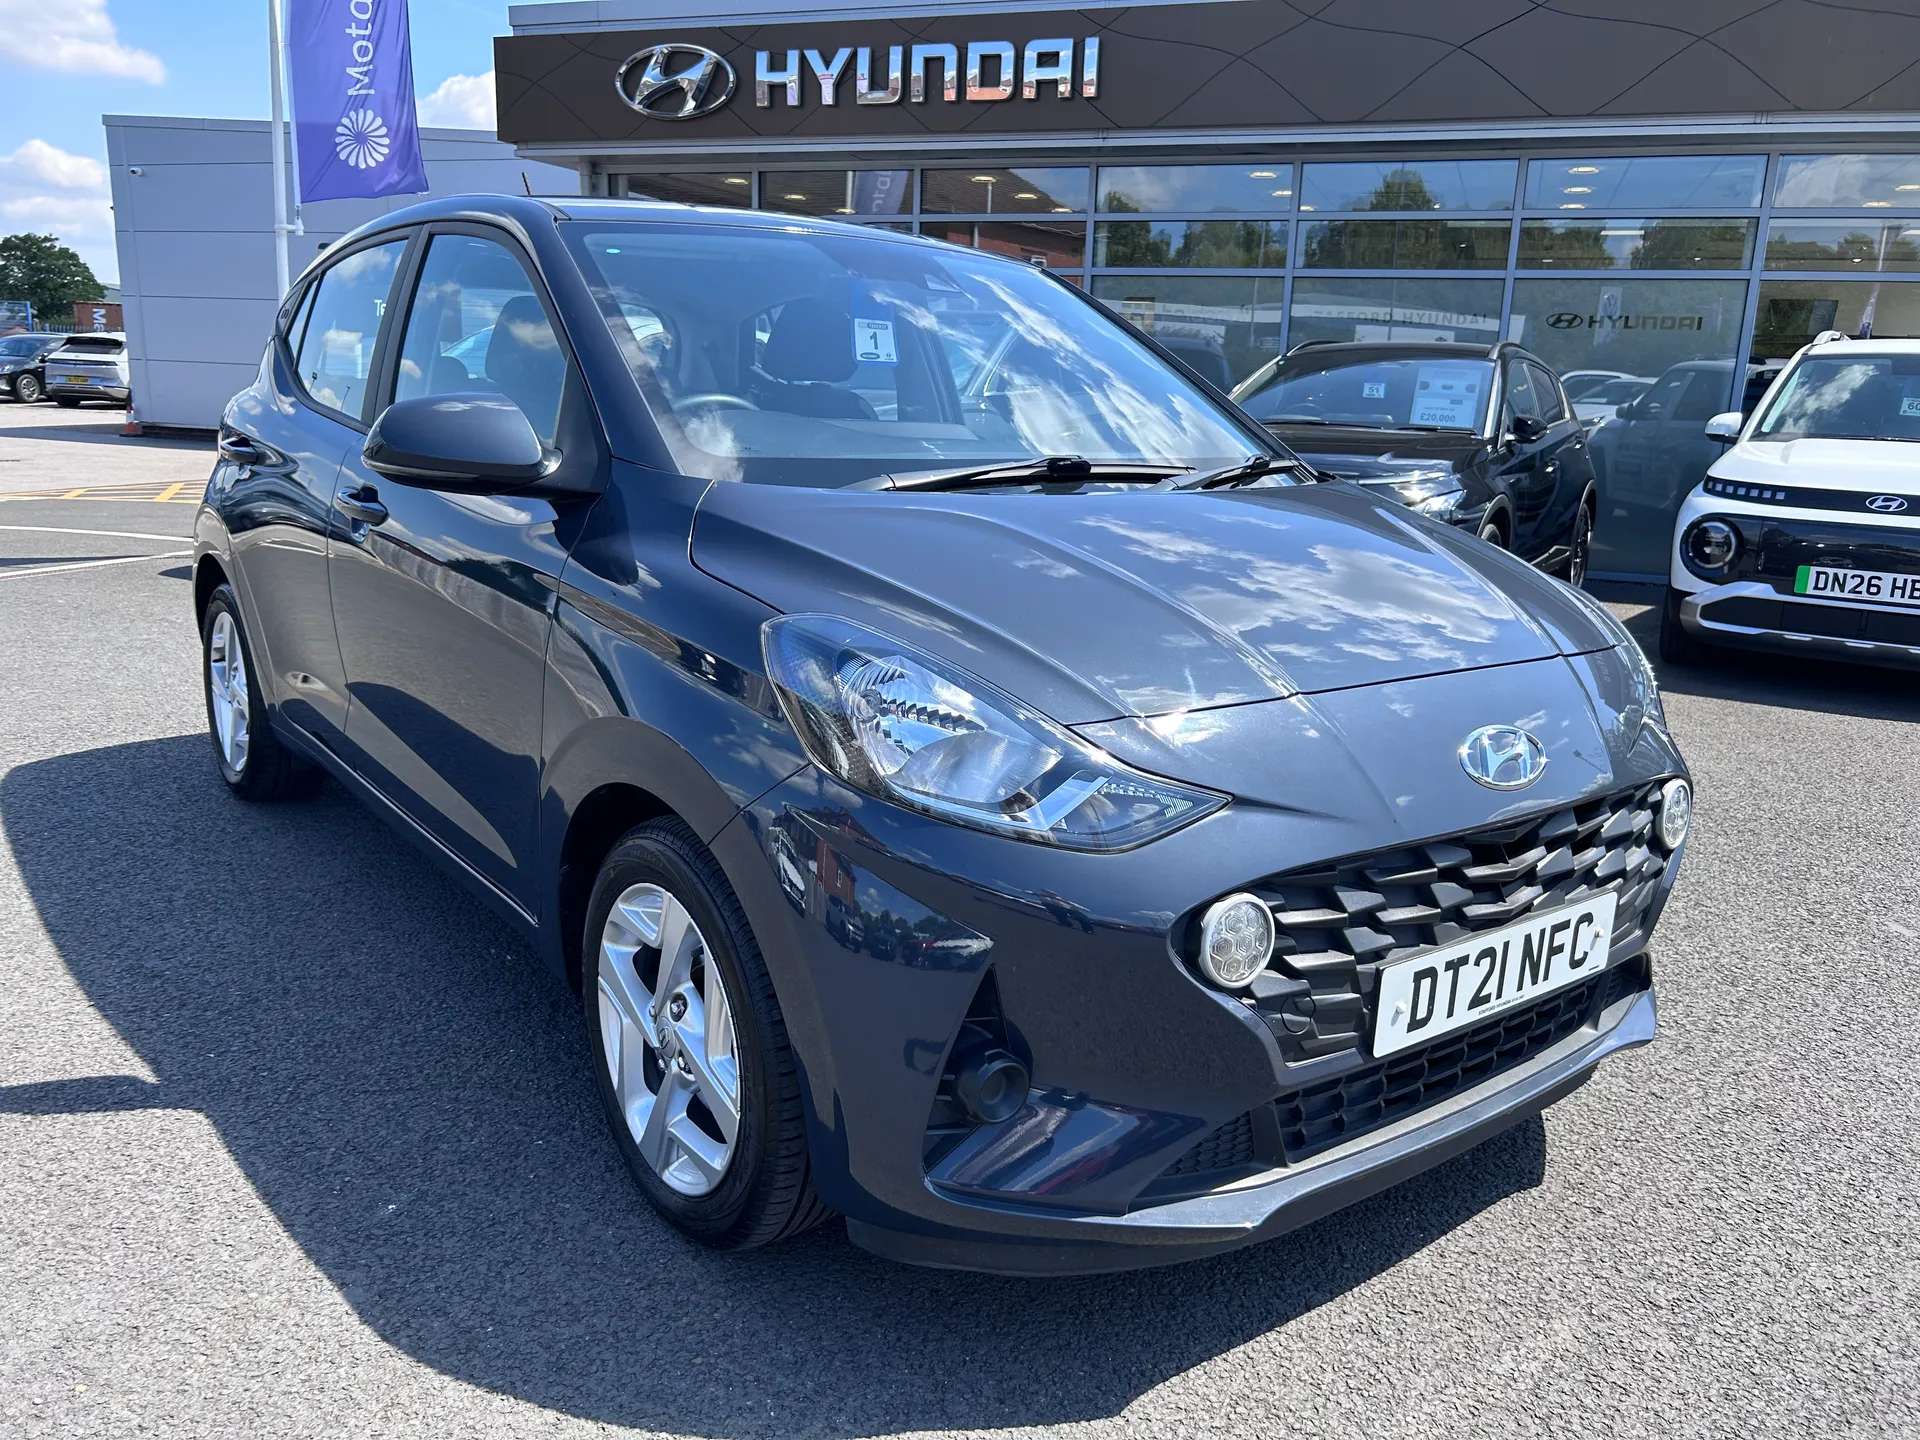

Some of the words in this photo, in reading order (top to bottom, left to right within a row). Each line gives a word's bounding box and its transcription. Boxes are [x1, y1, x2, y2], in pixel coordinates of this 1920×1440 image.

[755, 36, 1100, 108] HYUNDAI
[1588, 314, 1704, 331] HYUNDAI
[869, 331, 879, 350] 1
[1813, 570, 1883, 596] DN26
[1406, 940, 1511, 1034] DT21
[1516, 912, 1594, 993] NFC
